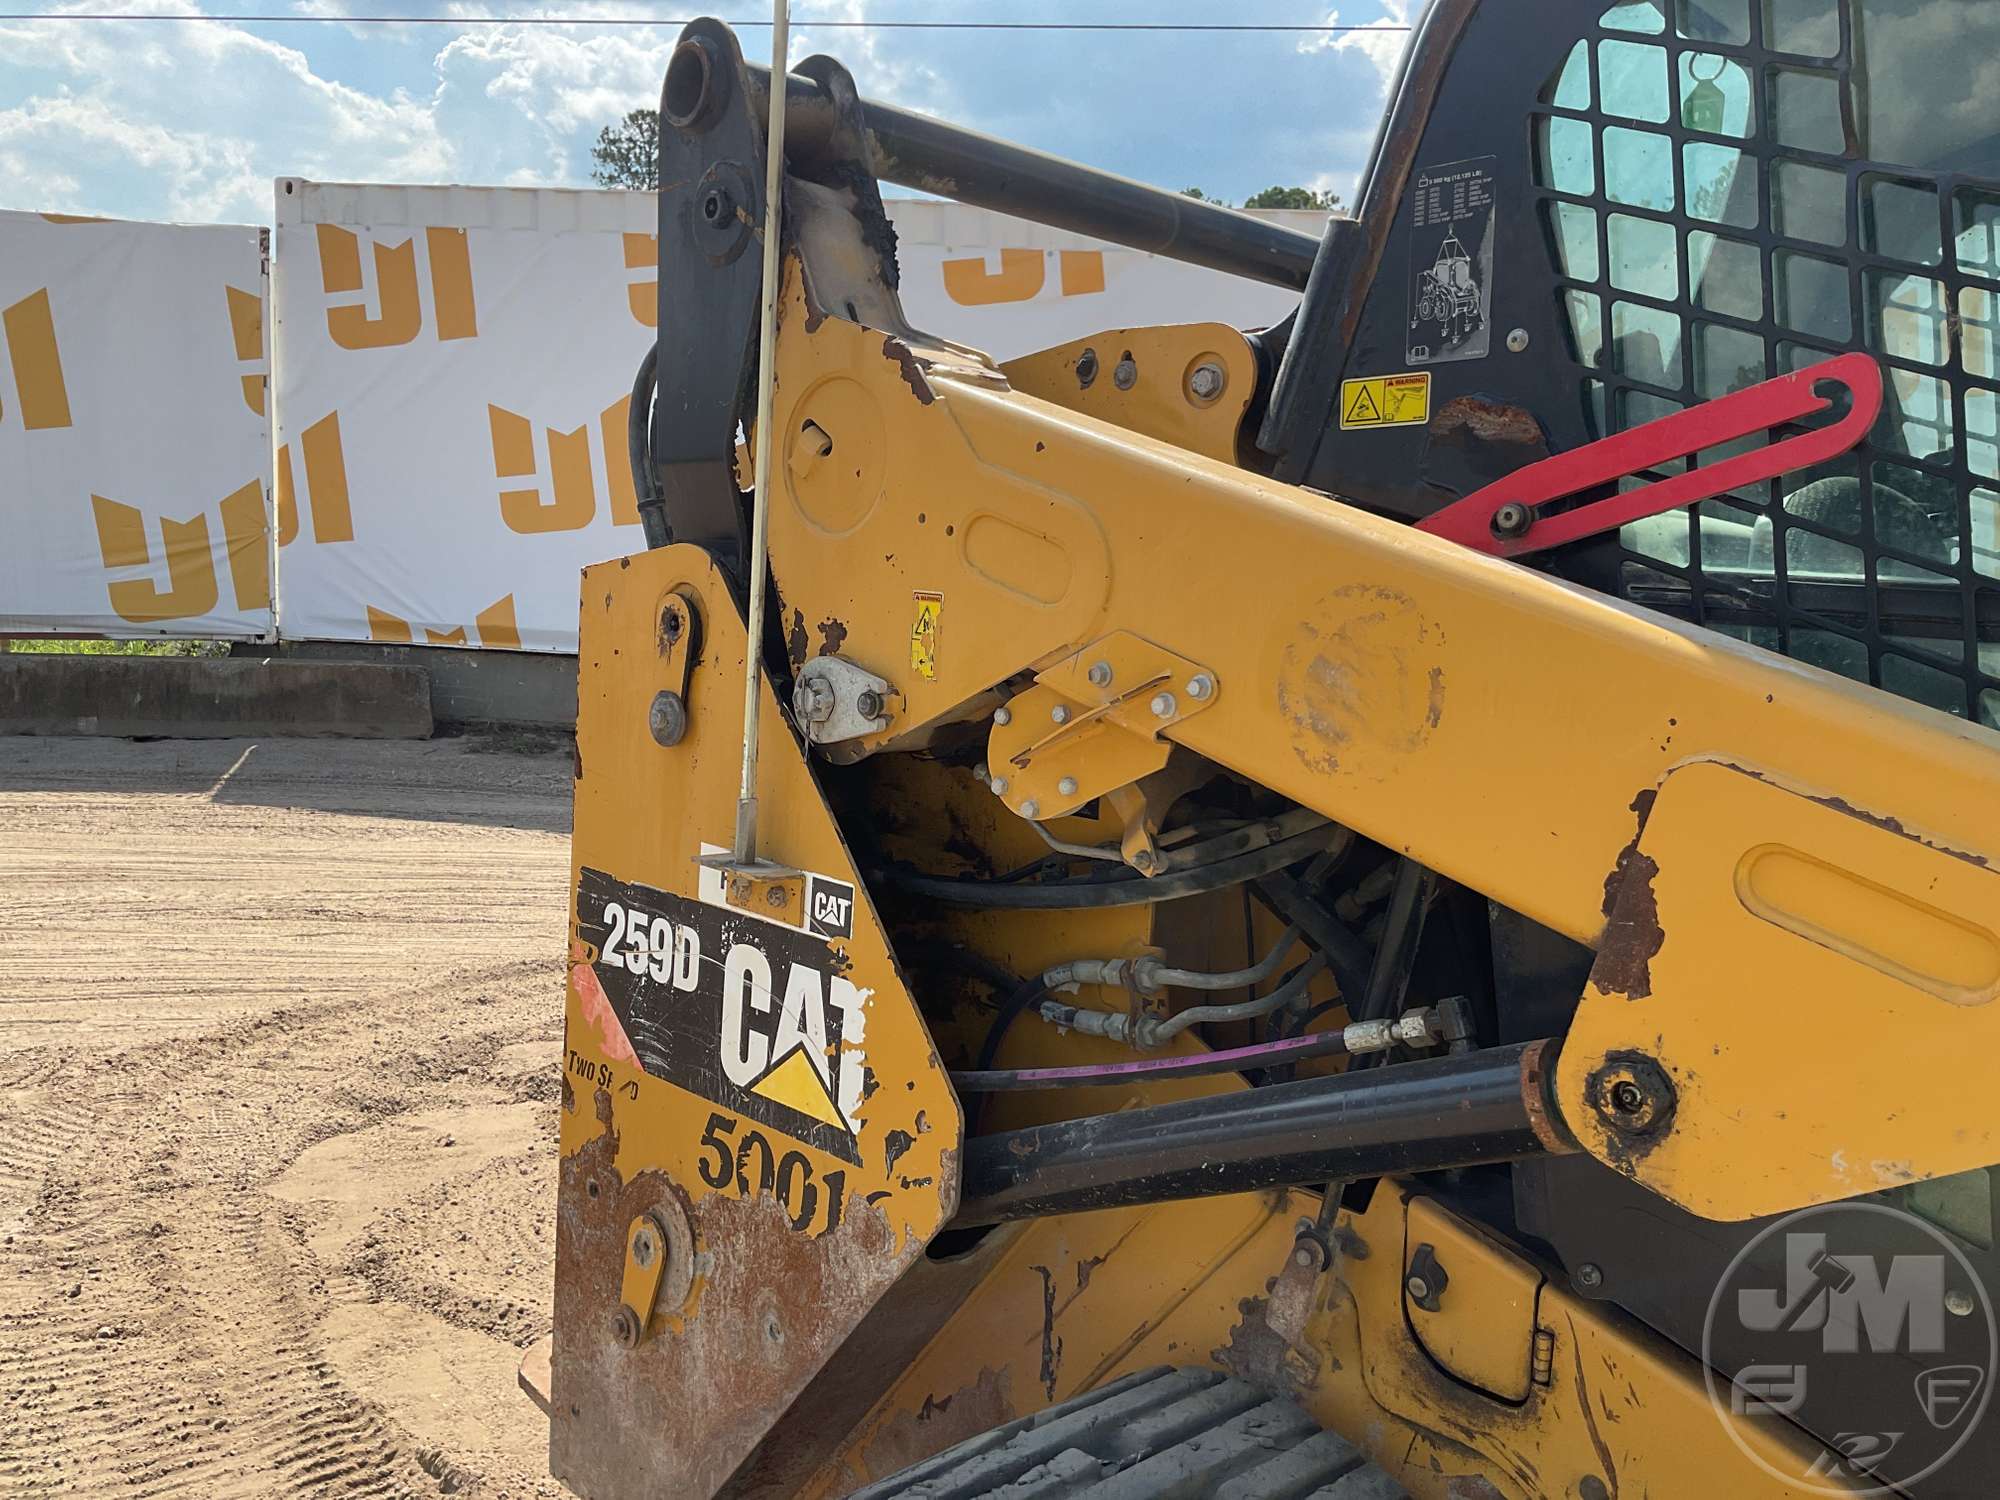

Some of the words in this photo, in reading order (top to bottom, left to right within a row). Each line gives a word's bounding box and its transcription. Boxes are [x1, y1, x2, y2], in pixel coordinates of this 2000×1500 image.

[601, 902, 701, 993] 259D
[814, 891, 852, 928] CAT
[569, 1049, 596, 1081] TWO
[720, 943, 870, 1135] CAT
[699, 1111, 846, 1236] 5001
